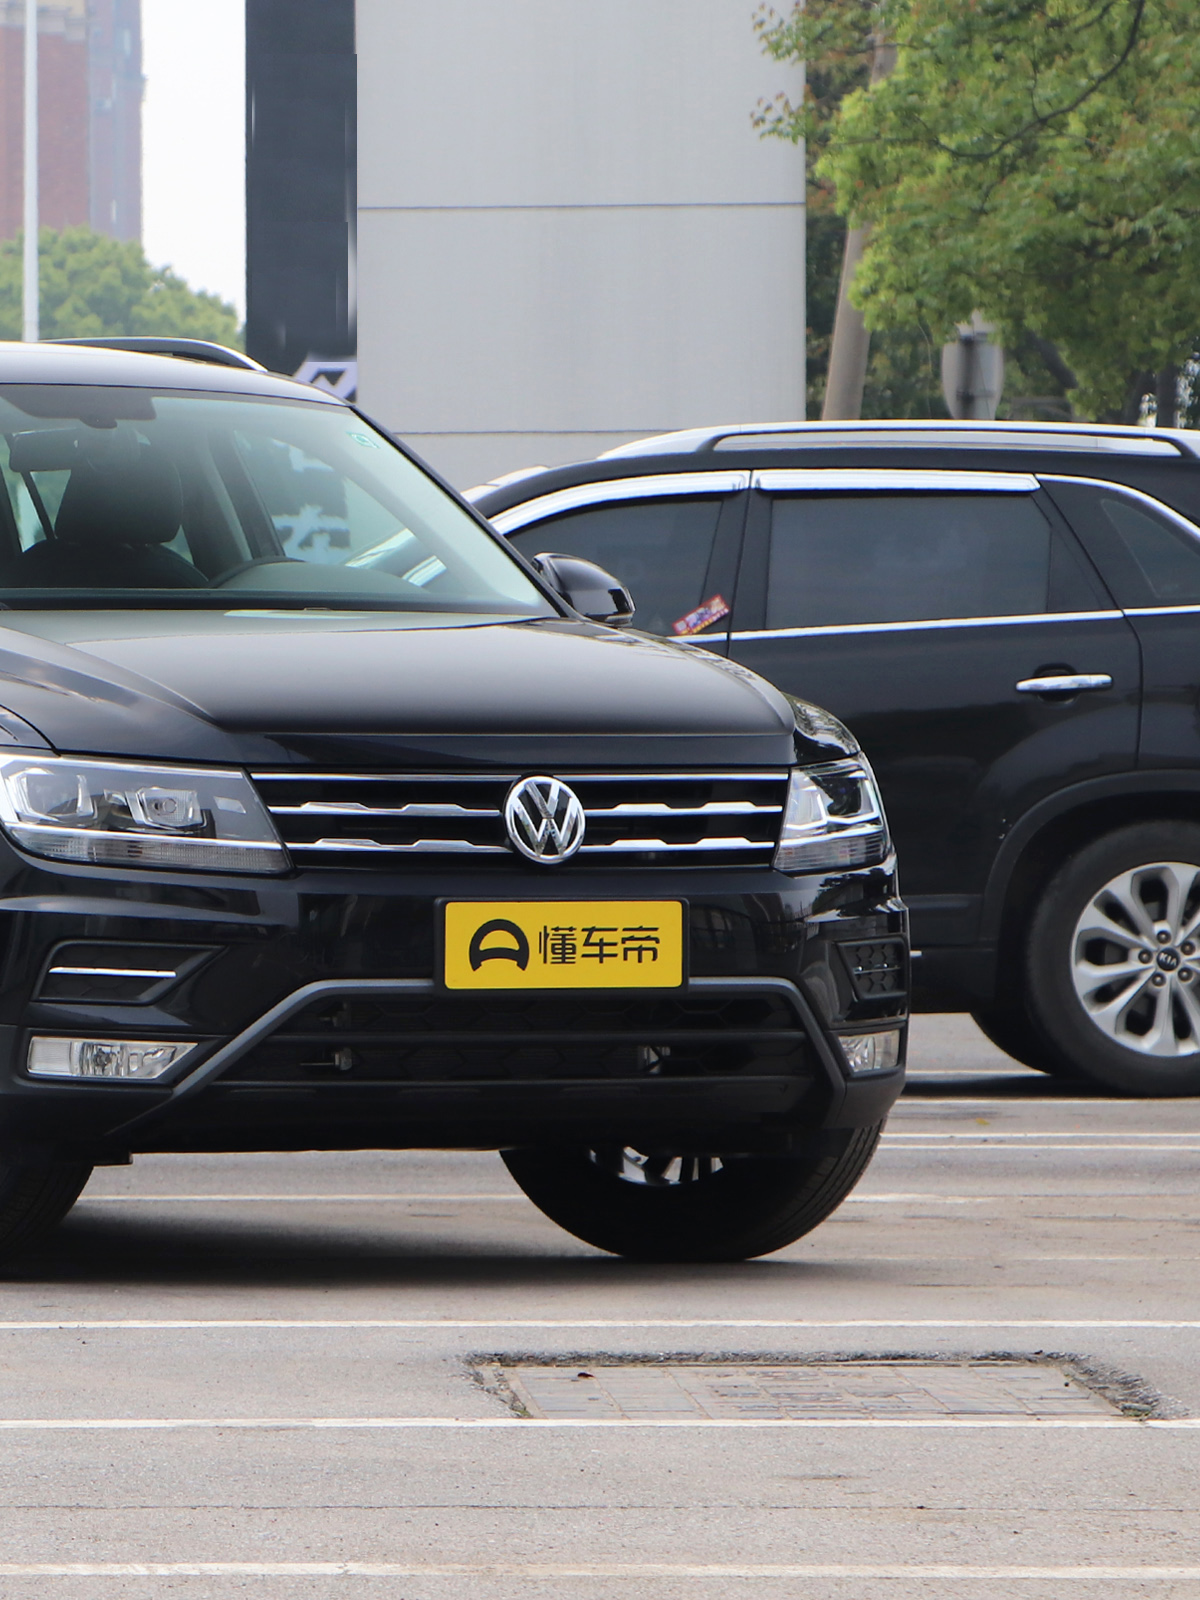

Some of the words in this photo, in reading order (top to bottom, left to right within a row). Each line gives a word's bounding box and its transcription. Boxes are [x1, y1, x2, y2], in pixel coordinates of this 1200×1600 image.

[506, 776, 586, 864] VW
[538, 924, 661, 965] 懂车帝
[1159, 952, 1177, 966] KIA
